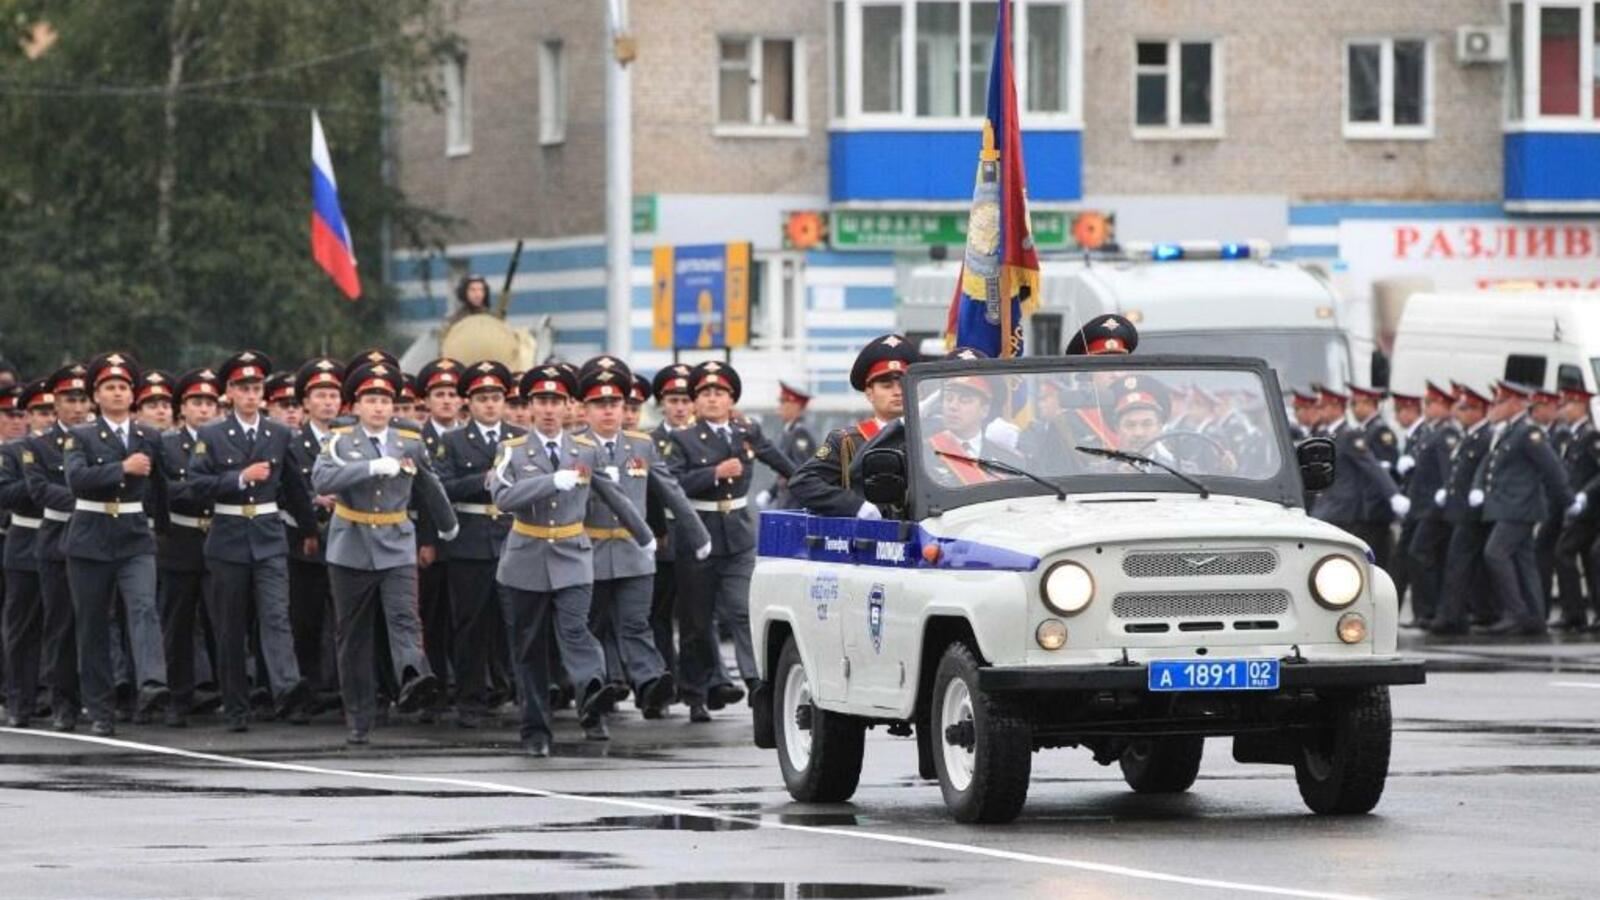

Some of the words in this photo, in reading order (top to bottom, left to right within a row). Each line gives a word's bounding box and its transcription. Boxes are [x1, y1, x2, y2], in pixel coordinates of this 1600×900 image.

[1394, 224, 1600, 258] РАЗЛИВ
[1184, 664, 1237, 687] 1891
[1250, 662, 1271, 679] 02
